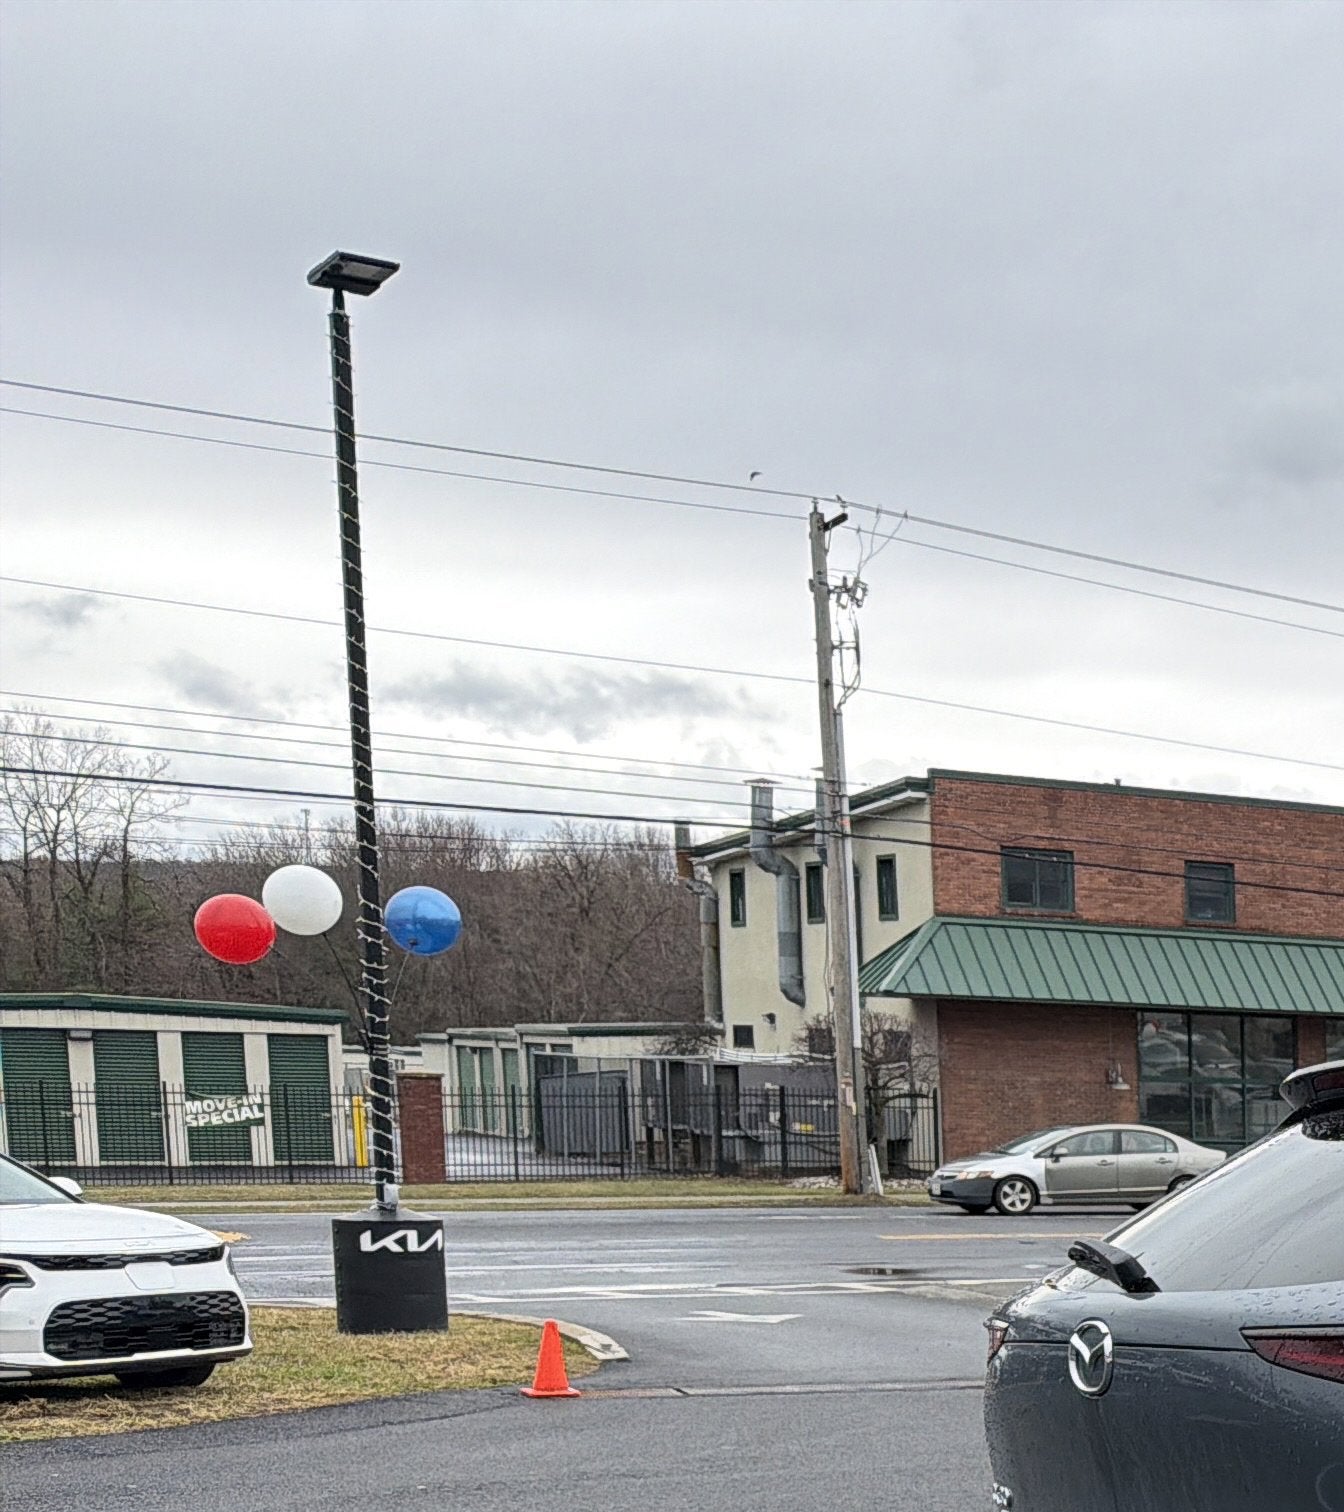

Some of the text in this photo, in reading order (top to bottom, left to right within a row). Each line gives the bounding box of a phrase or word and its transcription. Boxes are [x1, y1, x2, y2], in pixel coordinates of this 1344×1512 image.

[185, 1093, 262, 1114] MOVE-IN
[185, 1105, 265, 1127] SPECIAL
[359, 1229, 443, 1252] KIA
